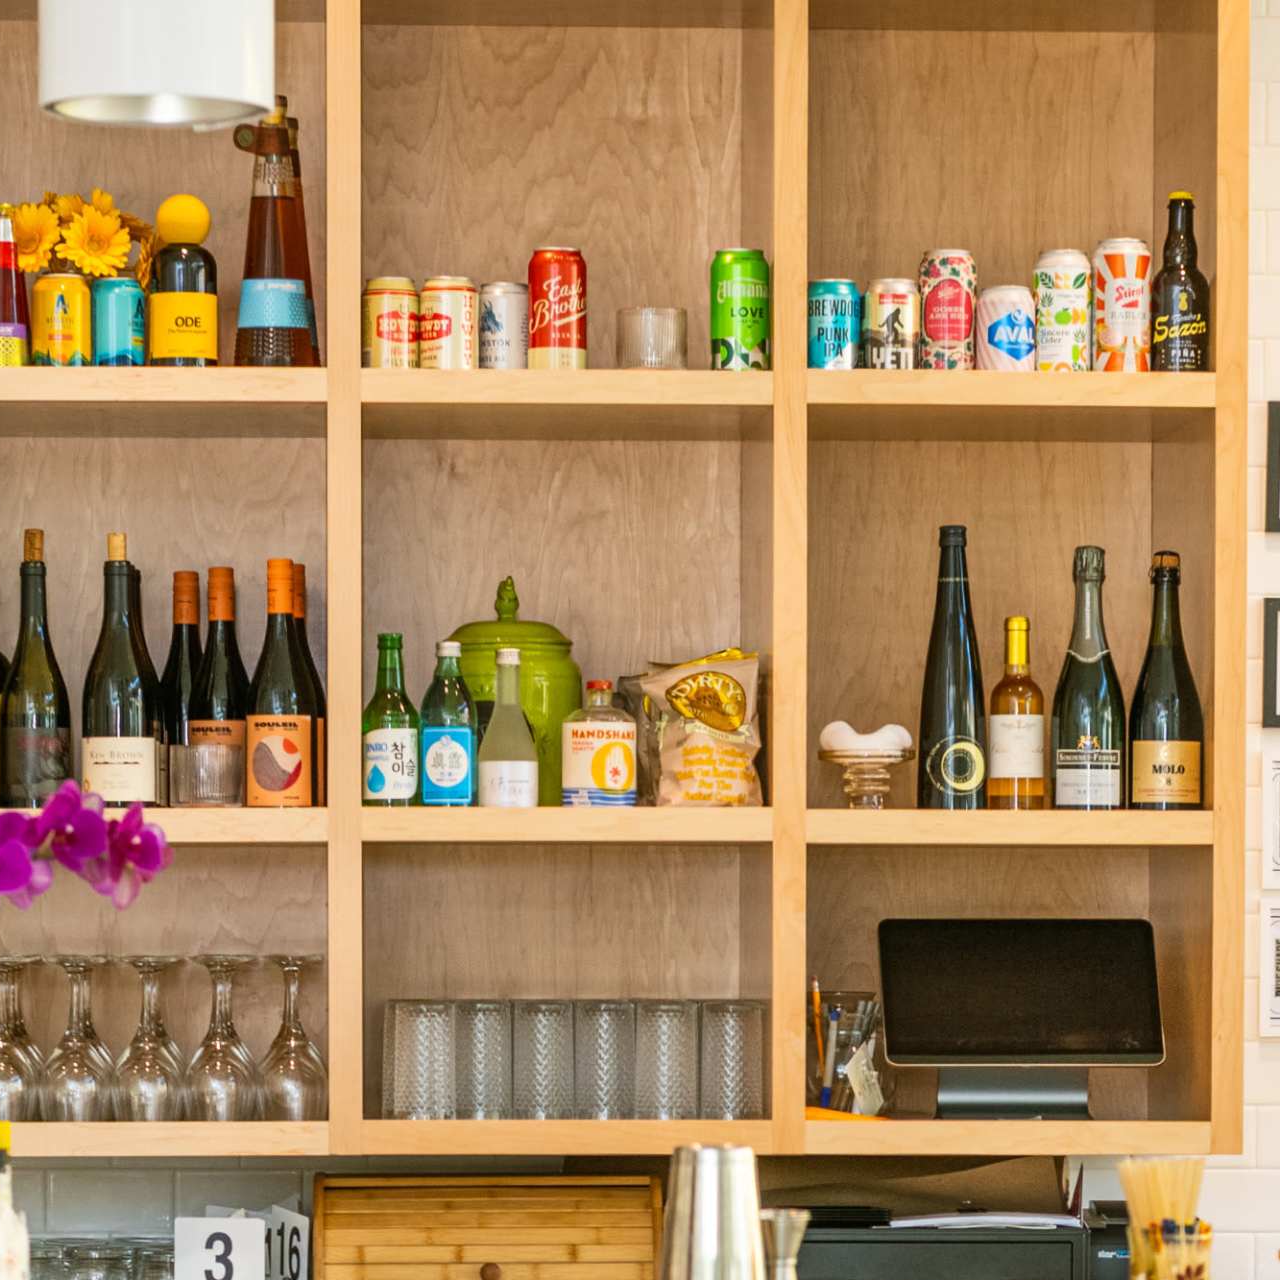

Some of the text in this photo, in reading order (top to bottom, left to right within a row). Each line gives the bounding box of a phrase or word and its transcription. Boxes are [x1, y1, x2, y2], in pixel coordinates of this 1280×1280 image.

[730, 306, 765, 318] LOVE
[174, 316, 201, 328] ODE
[817, 327, 849, 342] PUNK
[824, 343, 843, 357] IPA
[872, 346, 914, 369] YETI
[1152, 764, 1185, 775] MOLO
